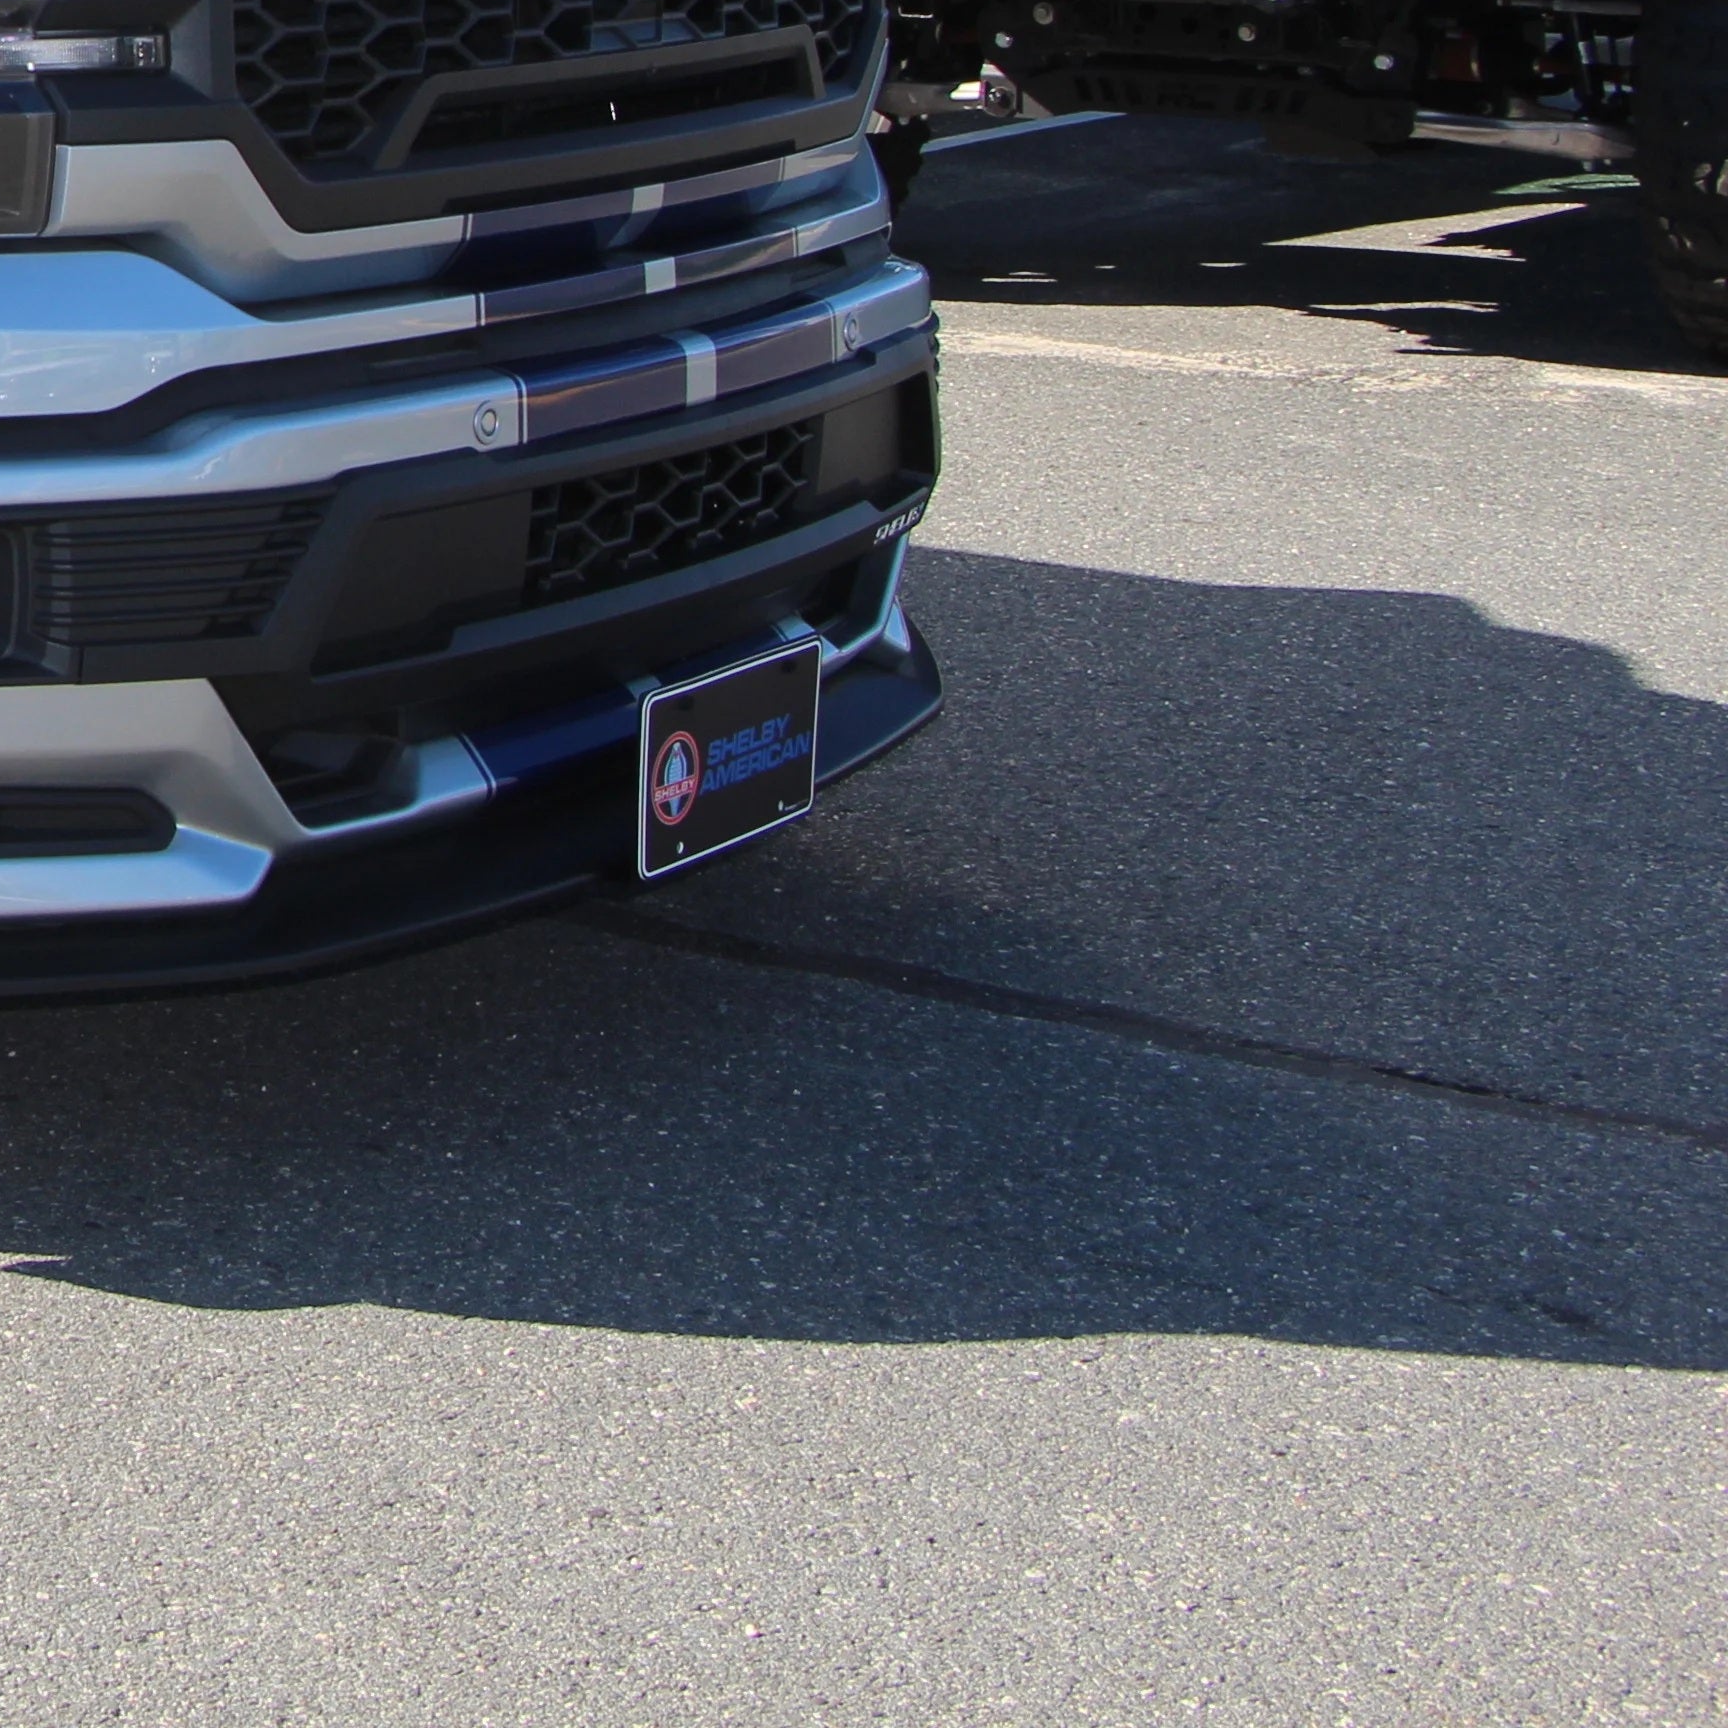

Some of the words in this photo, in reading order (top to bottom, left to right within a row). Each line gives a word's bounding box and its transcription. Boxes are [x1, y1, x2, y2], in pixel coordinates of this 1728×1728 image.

[698, 730, 813, 797] AMERICAN
[707, 712, 792, 767] SHELBY
[653, 778, 695, 803] SHELBY
